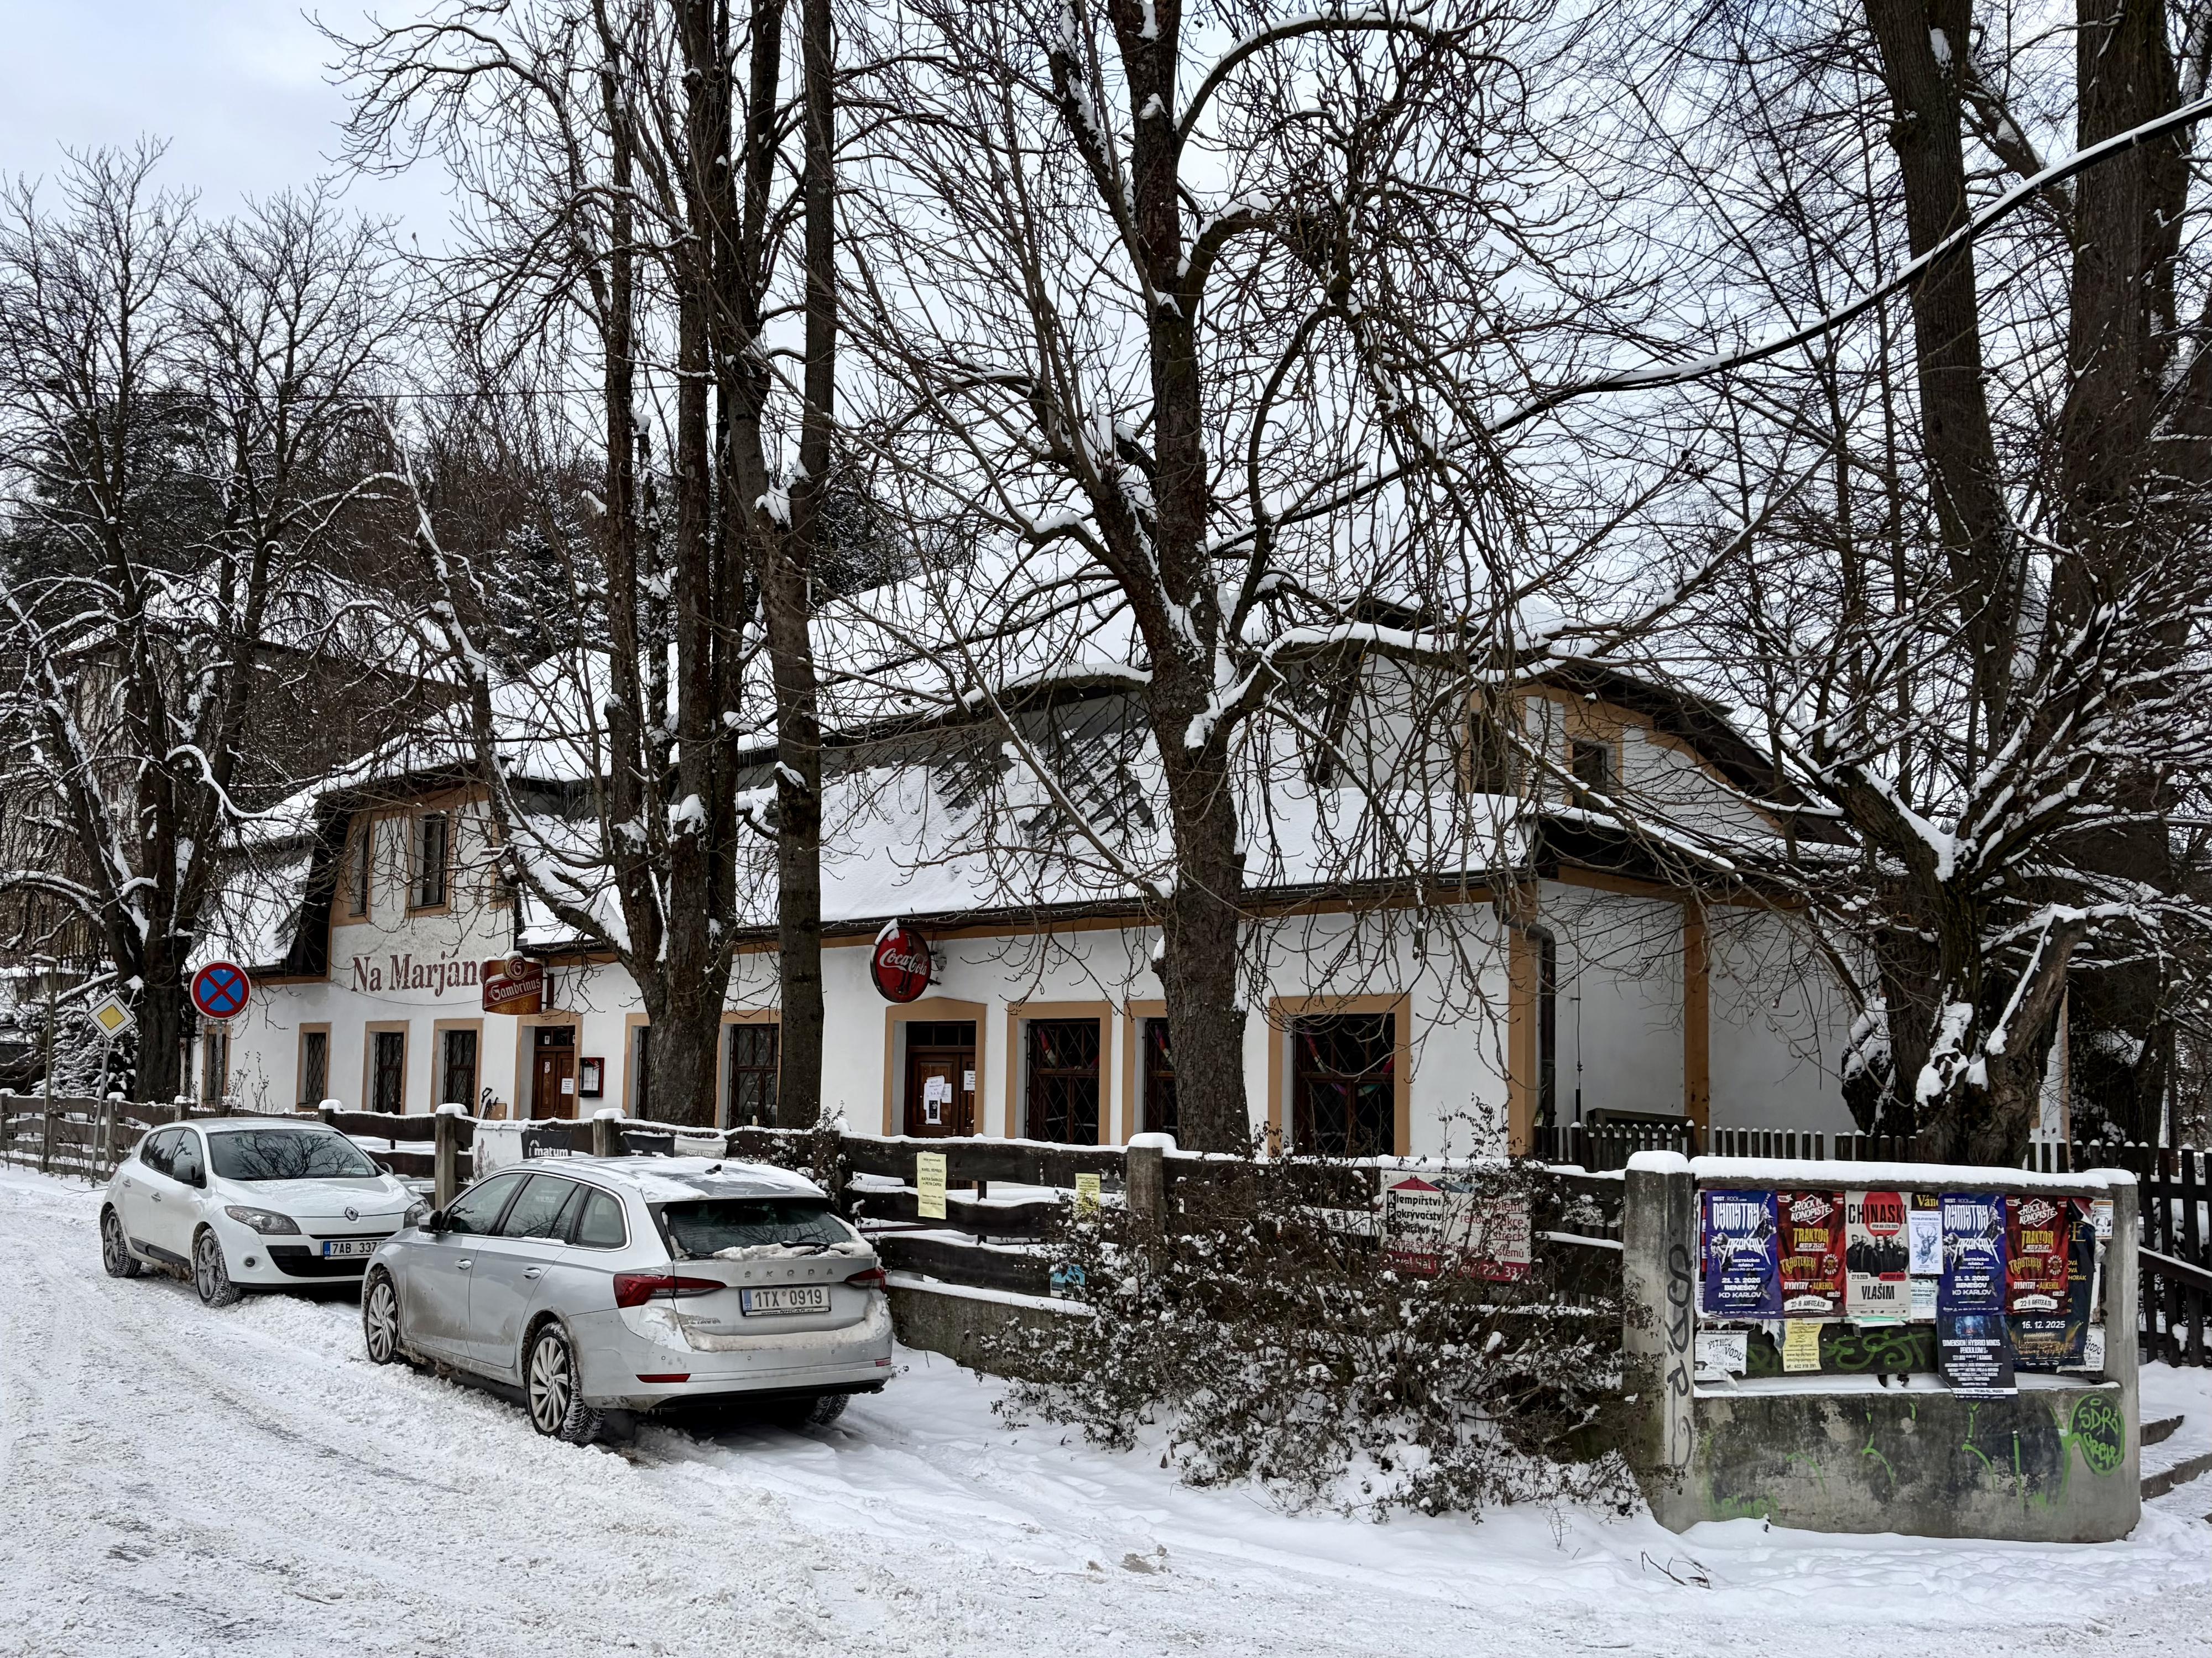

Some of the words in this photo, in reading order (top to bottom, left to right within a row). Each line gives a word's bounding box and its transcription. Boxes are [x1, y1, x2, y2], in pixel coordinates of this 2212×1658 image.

[879, 948, 927, 976] Coca-Cola
[351, 956, 382, 992] Na
[488, 979, 541, 1001] Gambrinus
[534, 1147, 568, 1157] matum
[1388, 1209, 1442, 1221] Pokrývačstv
[1794, 1200, 1815, 1212] ROCK
[1848, 1204, 1907, 1224] CHINASKI
[1713, 1203, 1759, 1231] DYMYTRY
[1944, 1205, 1989, 1231] DYMYTRY
[1793, 1228, 1829, 1248] TRAKTOR
[2021, 1230, 2054, 1249] TRAKTOR
[333, 1243, 351, 1254] 7AB
[359, 1241, 382, 1253] 337
[1784, 1282, 1809, 1290] DYMYTRY
[1861, 1283, 1895, 1300] VLAŠIM
[755, 1291, 779, 1307] 1TX
[790, 1289, 822, 1305] 0919
[2045, 1320, 2066, 1329] 2025
[1725, 1346, 1744, 1361] VODU
